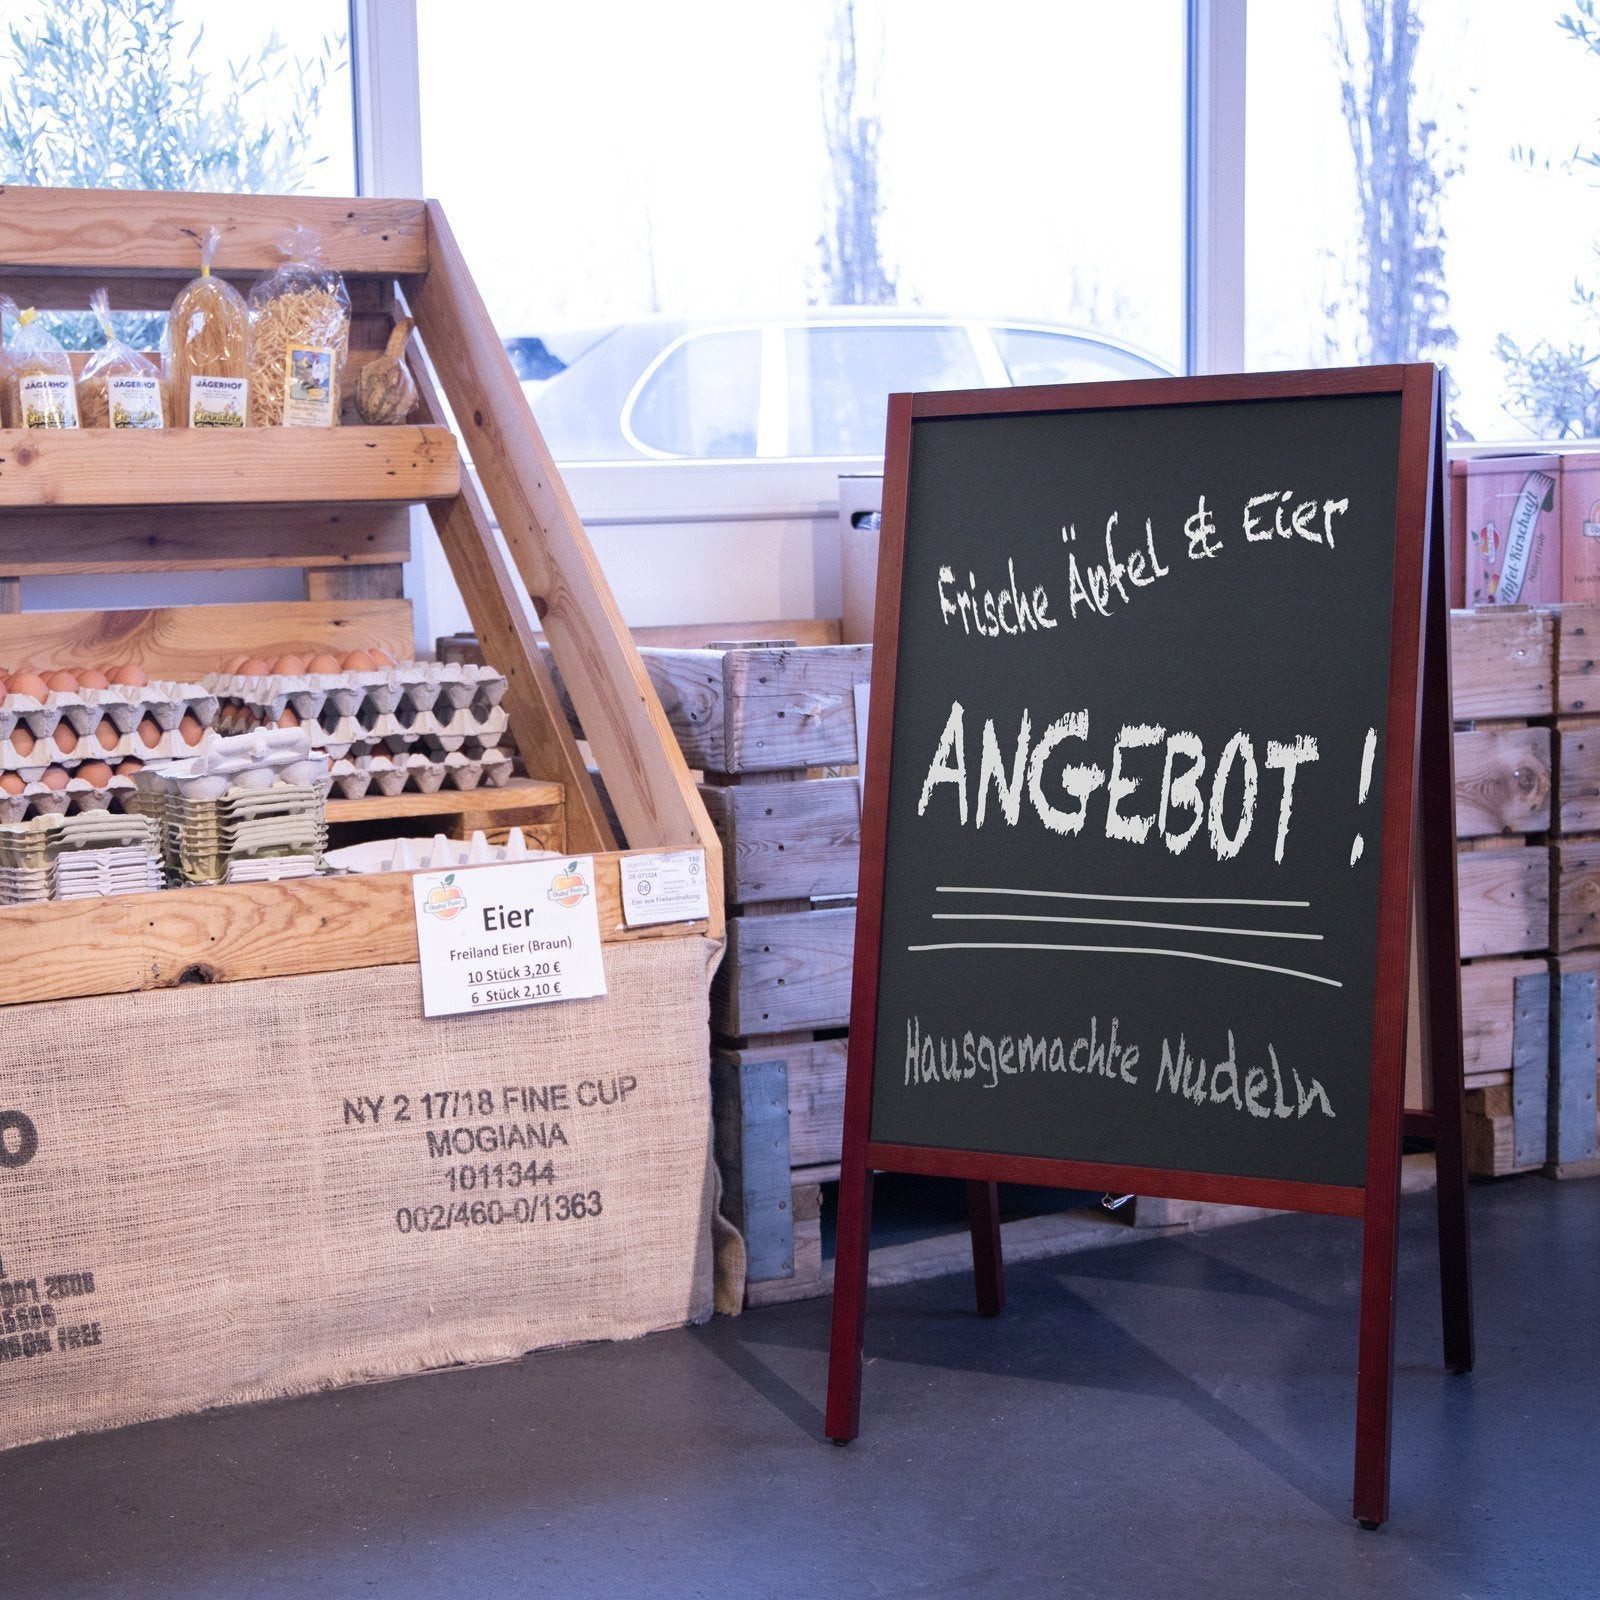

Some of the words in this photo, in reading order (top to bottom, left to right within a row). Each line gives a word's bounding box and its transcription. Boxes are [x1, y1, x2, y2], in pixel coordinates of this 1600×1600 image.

[195, 378, 243, 390] JÄGERHOF
[938, 557, 1058, 638] Frische
[1061, 511, 1170, 619] Äpfel
[1183, 495, 1224, 560] &
[1242, 490, 1350, 549] Eier
[916, 700, 1320, 865] ANGEBOT
[1350, 726, 1378, 868] !
[483, 904, 535, 932] Eier
[449, 944, 499, 961] Freiland
[502, 942, 525, 955] Eier
[528, 935, 573, 954] (Braun)
[467, 970, 483, 984] 10
[486, 966, 520, 982] Stück
[523, 961, 550, 979] 3,20
[553, 961, 562, 973] €
[471, 991, 480, 1004] 6
[486, 986, 520, 1003] Stück
[523, 982, 550, 999] 2,10
[553, 981, 562, 994] €
[904, 1015, 1140, 1088] Hausgemachte
[1155, 1029, 1337, 1119] Nudeln
[343, 1095, 384, 1125] NY
[393, 1094, 412, 1122] 2
[420, 1089, 495, 1121] 17/18
[502, 1084, 570, 1114] FINE
[576, 1075, 638, 1107] CUP
[425, 1121, 568, 1159] MOGIANA
[444, 1159, 556, 1192] 1011344
[396, 1190, 603, 1234] 002/460-0/1363
